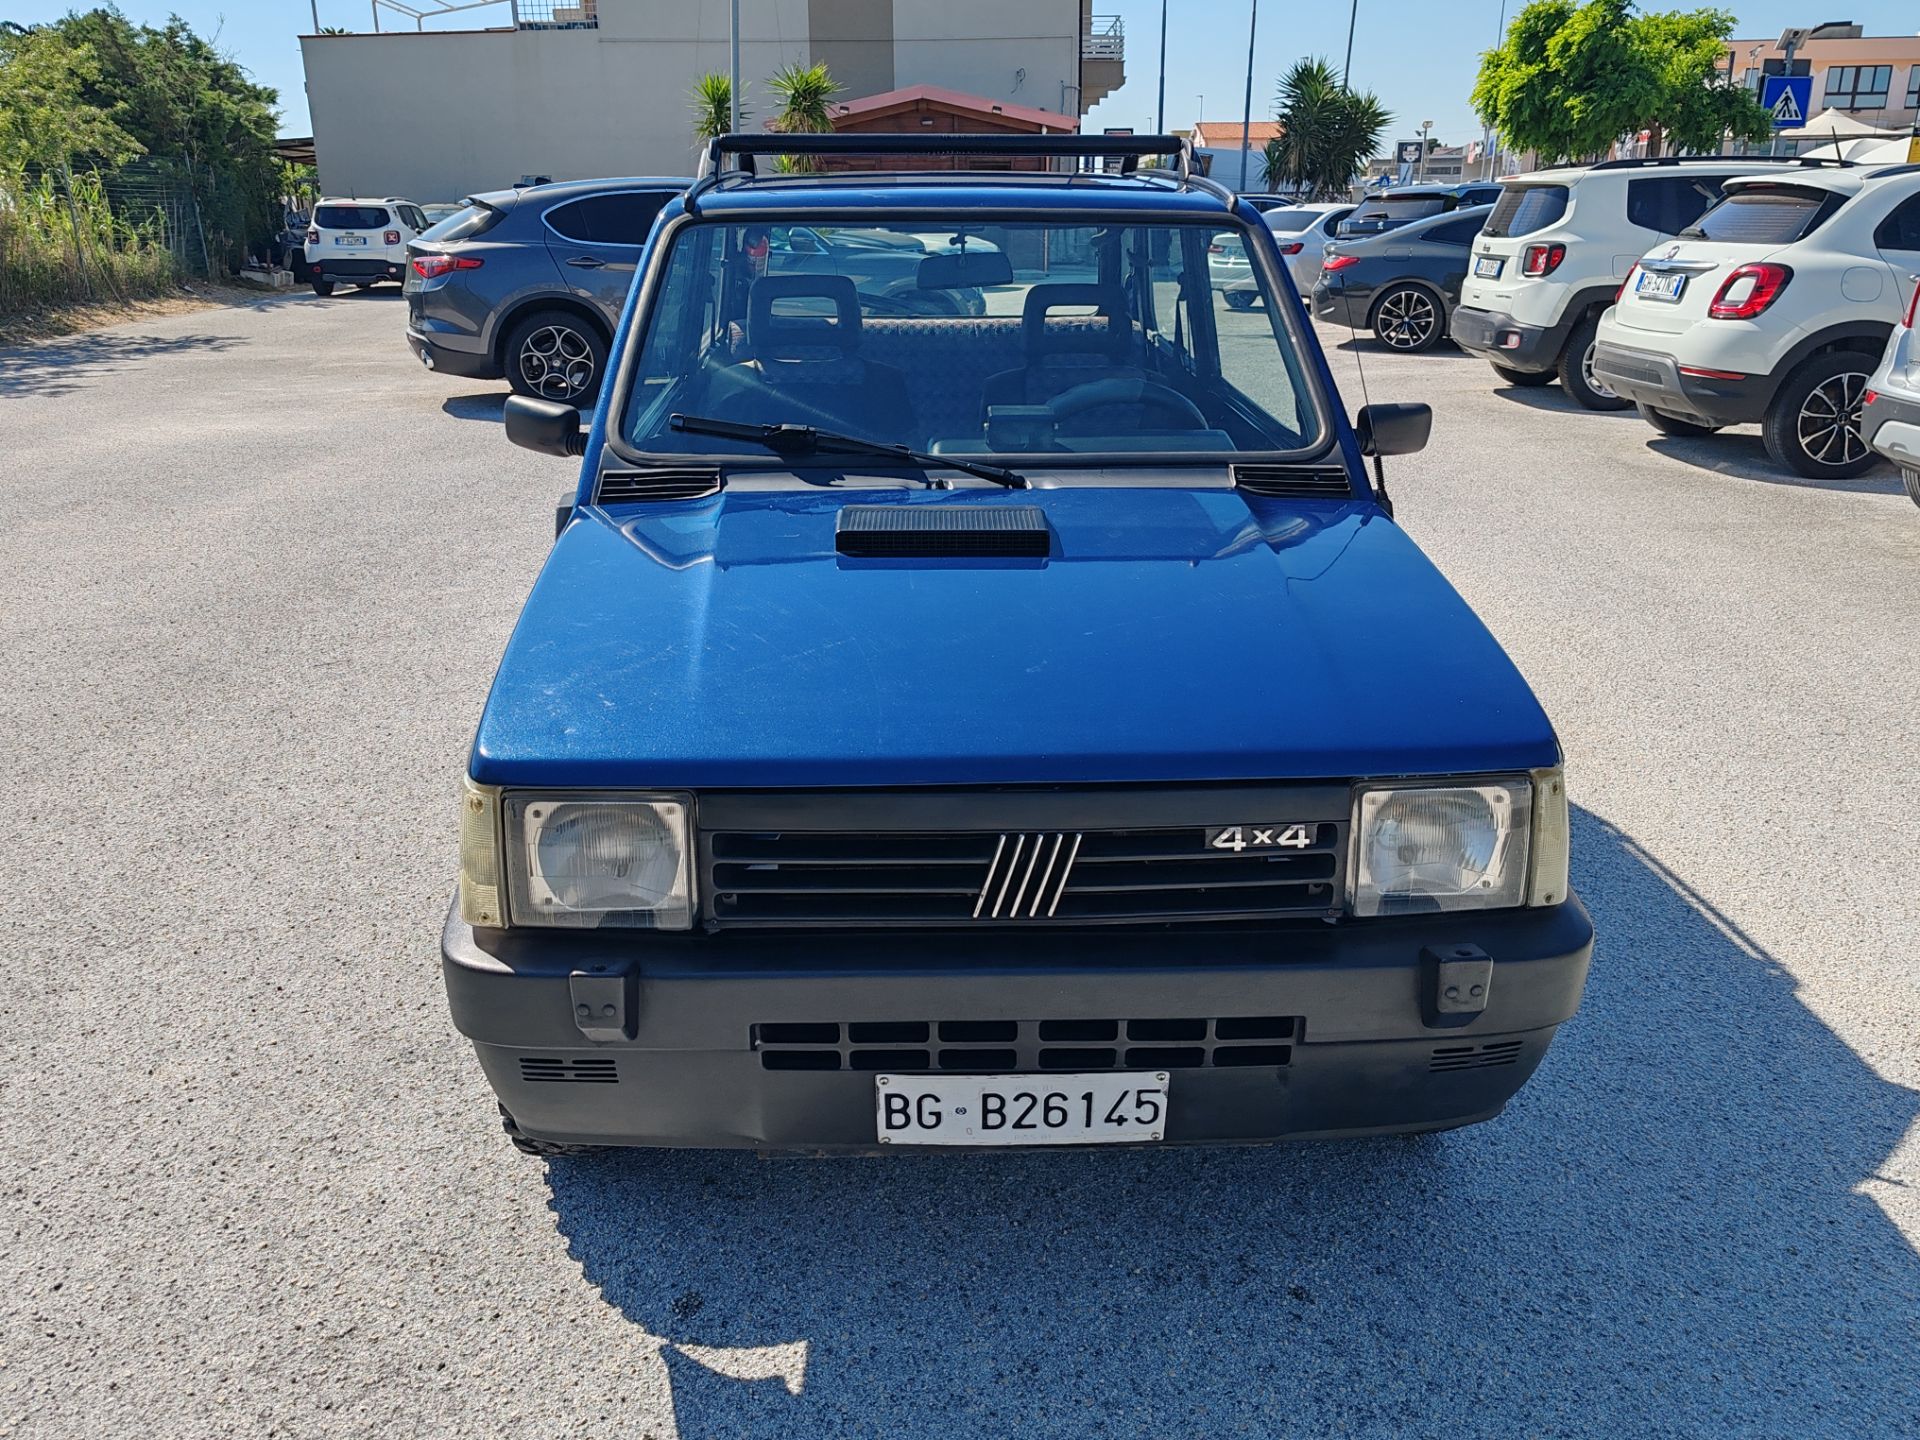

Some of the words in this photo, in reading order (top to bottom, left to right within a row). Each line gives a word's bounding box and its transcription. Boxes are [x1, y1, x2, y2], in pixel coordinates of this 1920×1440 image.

[1212, 824, 1311, 852] 4x4
[884, 1093, 942, 1130] BG
[981, 1089, 1162, 1130] B26145
